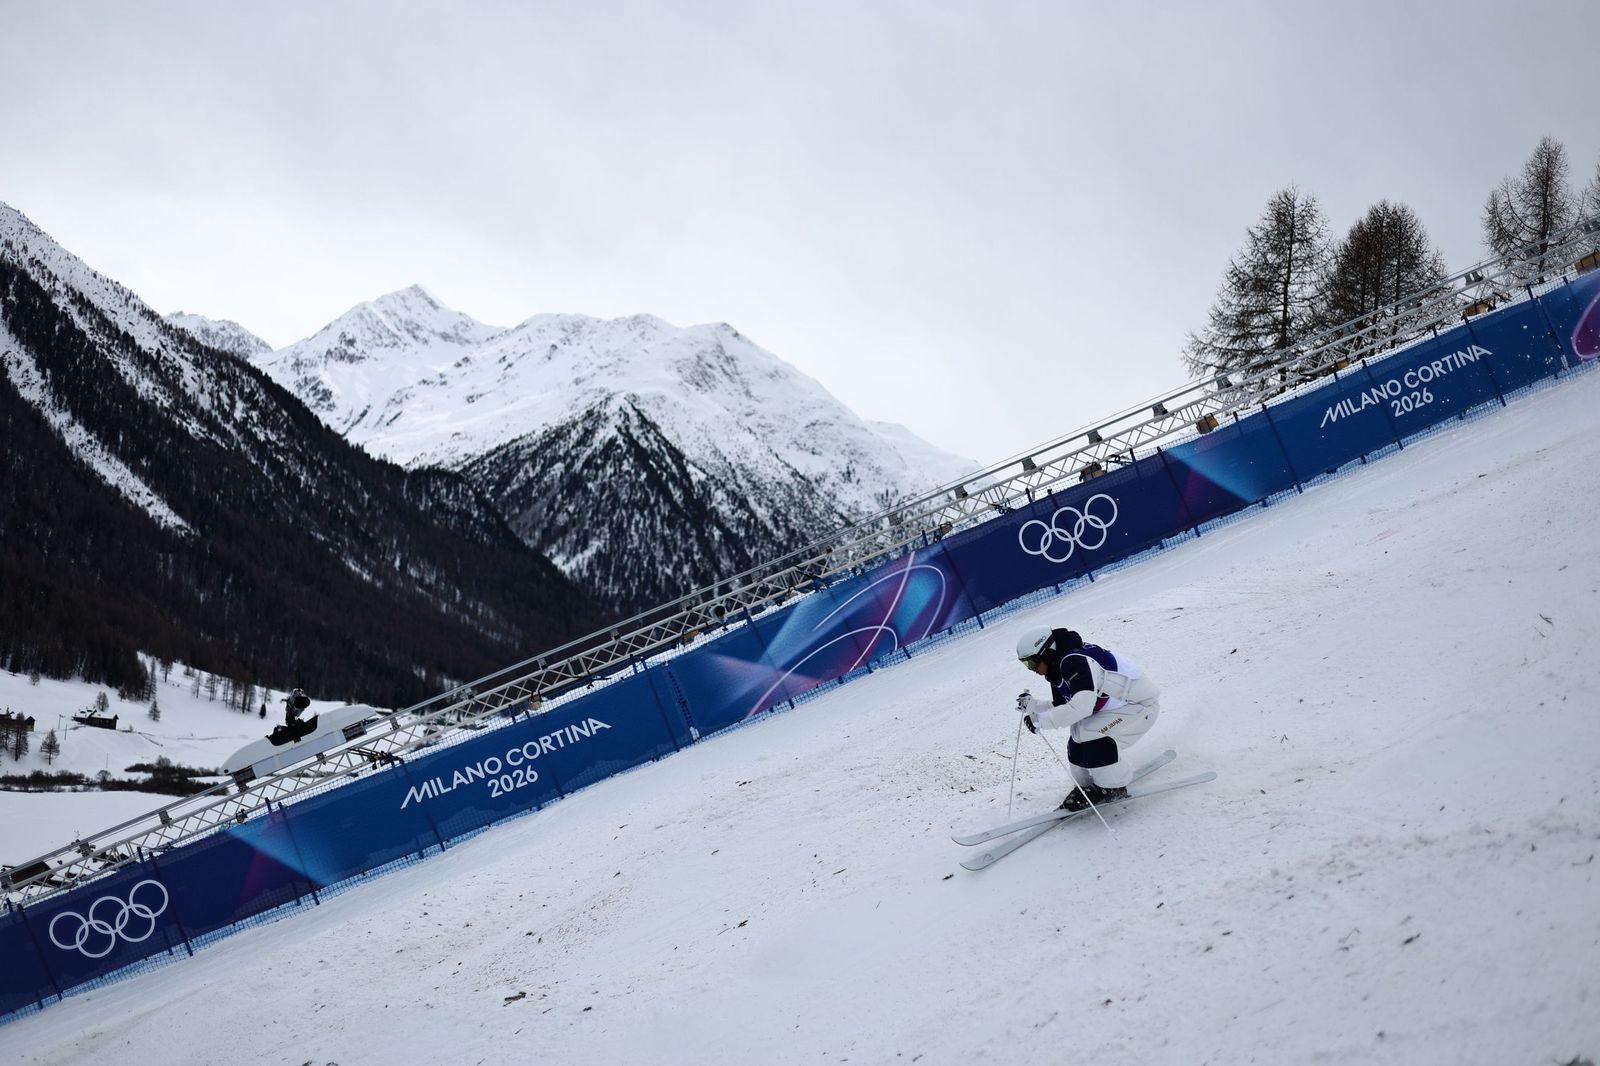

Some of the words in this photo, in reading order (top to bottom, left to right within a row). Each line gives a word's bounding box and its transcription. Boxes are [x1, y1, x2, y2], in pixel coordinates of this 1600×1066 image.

[1320, 379, 1401, 429] MILANO
[1404, 344, 1493, 388] CORTINA
[1390, 387, 1434, 417] 2026
[400, 756, 502, 809] MILANO
[506, 717, 612, 766] CORTINA
[487, 764, 539, 798] 2026
